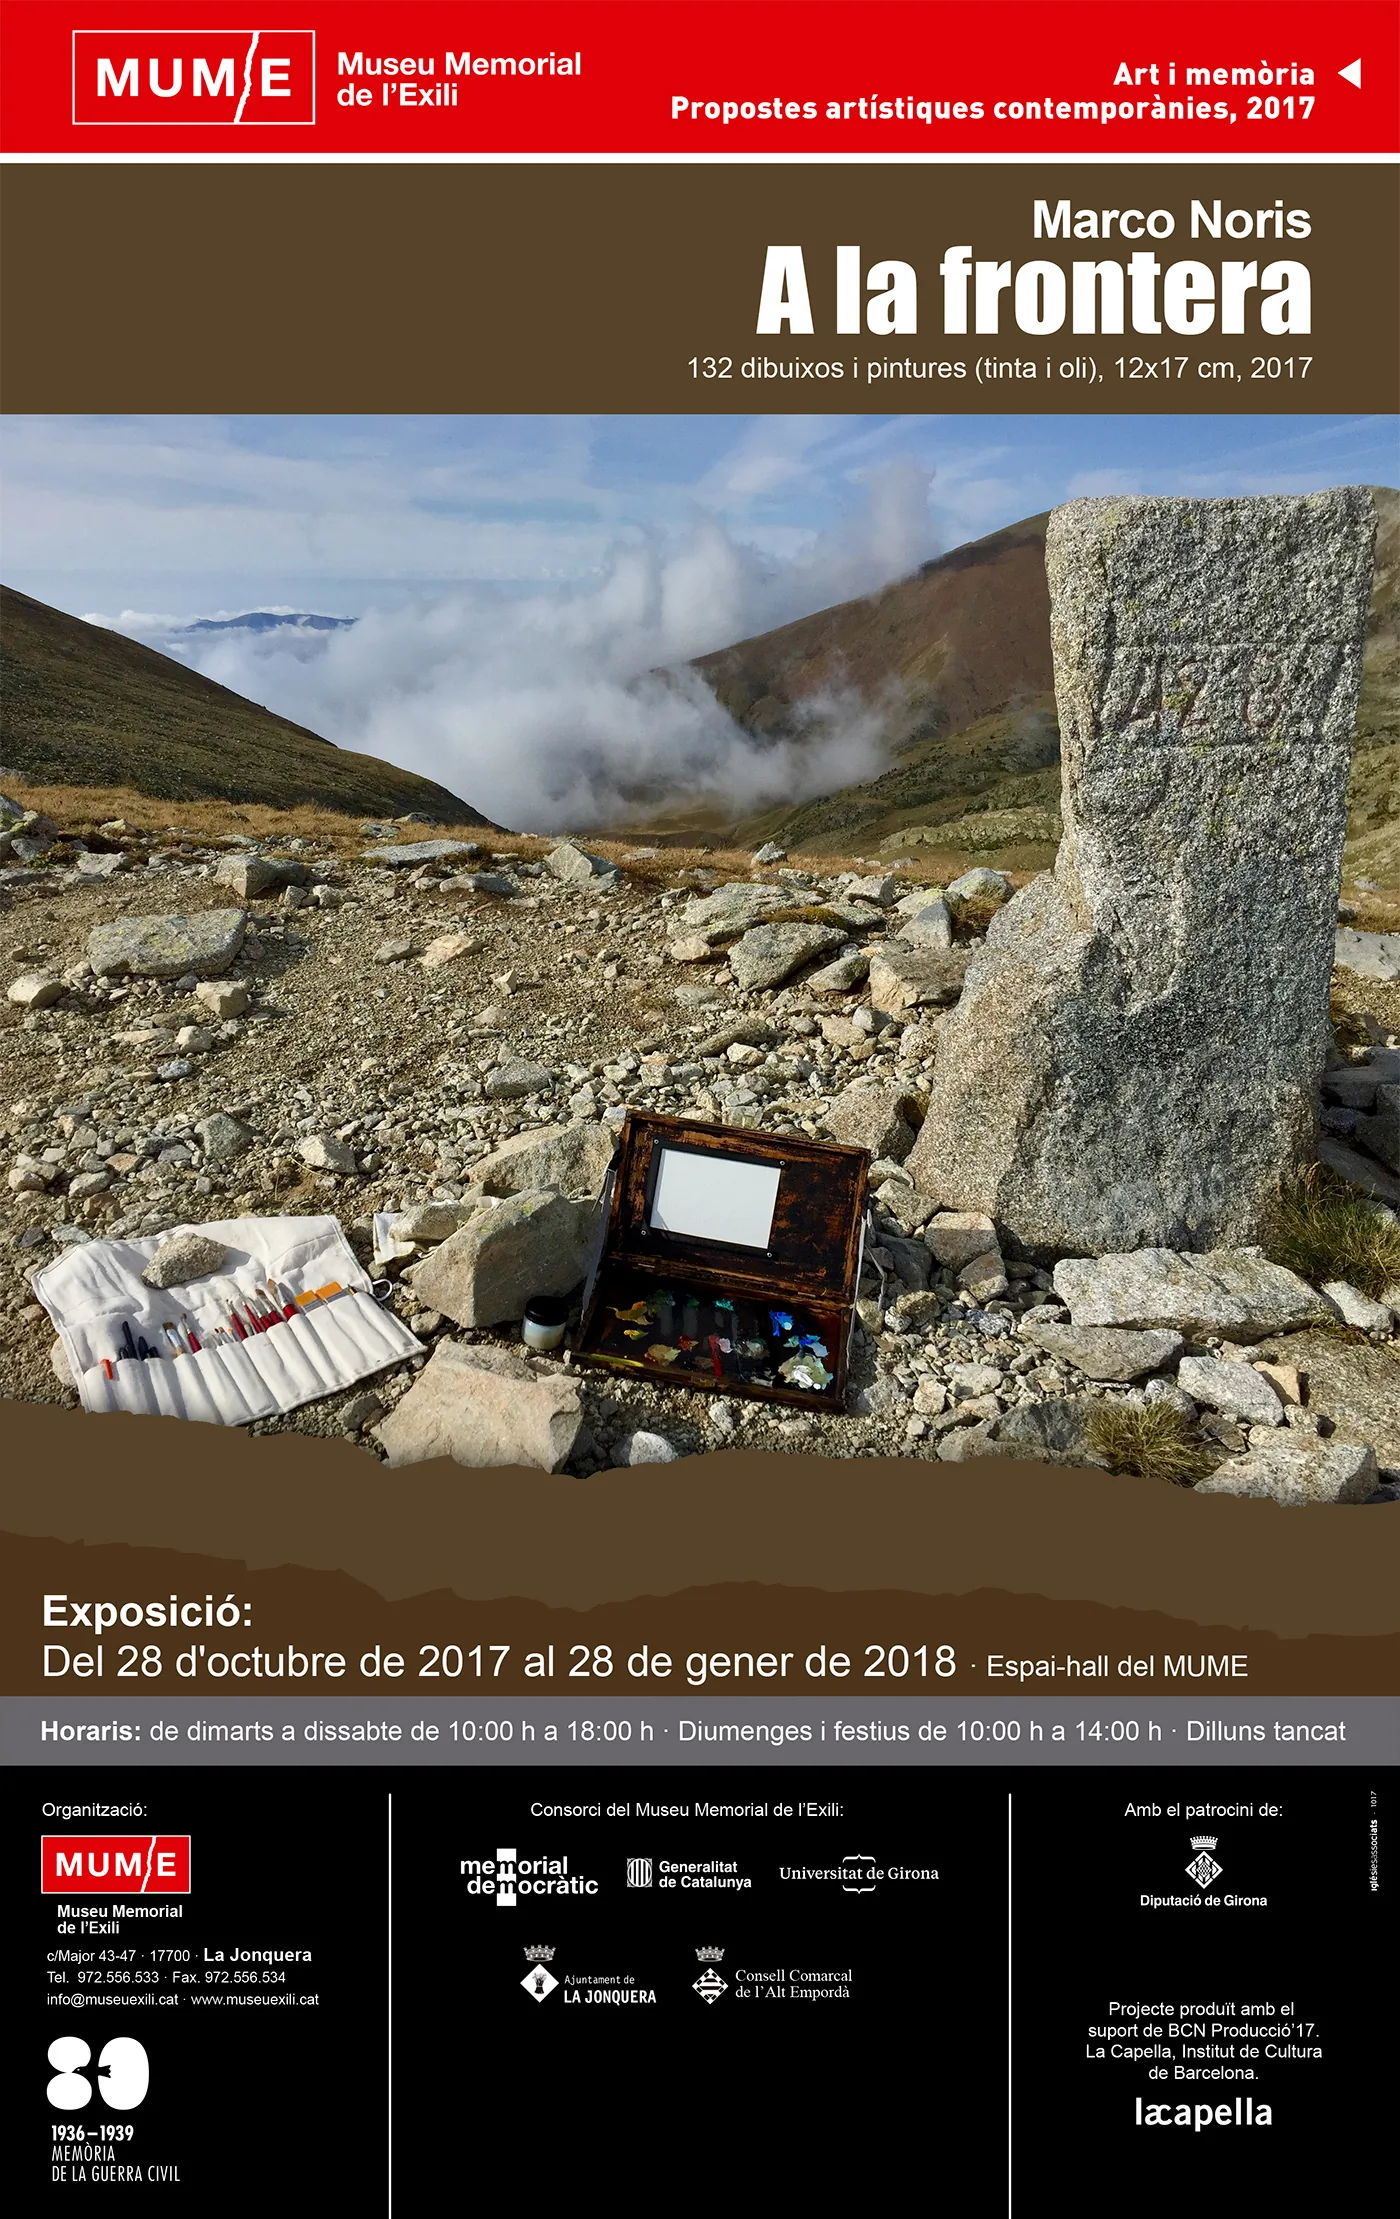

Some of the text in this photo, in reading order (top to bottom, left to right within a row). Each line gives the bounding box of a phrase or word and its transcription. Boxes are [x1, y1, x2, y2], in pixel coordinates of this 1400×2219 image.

[338, 52, 580, 75] Museu Memorial
[1113, 60, 1314, 85] Art i memòria
[337, 83, 372, 106] de
[672, 94, 1315, 124] Propostes artístiques contemporànies, 2017
[1034, 200, 1311, 238] Marco Noris
[756, 246, 1311, 335] A la frontera
[689, 357, 1312, 384] 132 dibuixos i pintures (tinta i oli), 12x17 cm, 2017
[44, 1594, 251, 1634] Exposició:
[44, 1645, 1248, 1685] Del 28 d'octubre de 2017 al 28 de gener de 2018 Espai-hall del MUME
[42, 1721, 1346, 1746] Horaris: de dimarts a dissabte de 10:00 h a 18:00 h Diumenges i festius de 10:00 h a 14:00 h Dilluns tancat
[42, 1803, 146, 1820] Organització:
[531, 1803, 600, 1816] Consorci
[607, 1803, 629, 1816] del
[636, 1803, 688, 1816] Museu
[695, 1803, 767, 1816] Memorial
[773, 1803, 793, 1816] de
[1124, 1803, 1282, 1820] Amb el patrocini de:
[461, 1856, 568, 1875] memorial
[659, 1861, 737, 1873] Generalitat
[779, 1867, 939, 1879] Universitat de Girona
[467, 1876, 599, 1894] democràtic
[659, 1876, 751, 1891] de Catalunya
[1141, 1894, 1267, 1909] Diputació de Girona
[58, 1905, 182, 1917] Museu Memorial
[57, 1921, 76, 1934] de
[47, 1948, 311, 1965] c/Major 43-47 17700 La Jonquera
[47, 1971, 286, 1983] Tel. 972.556.533 Fax. 972.556.534
[565, 1975, 634, 1985] Ajuntament de
[736, 1969, 852, 1981] Consell Comarcal
[48, 1993, 319, 2008] info@museuexili.cat www.museuexili.cat
[564, 1990, 656, 2006] LA JONQUERA
[736, 1986, 750, 1997] de
[790, 1986, 849, 2001] Empordà
[1110, 2002, 1294, 2019] Projecte produït amb el
[1089, 2024, 1138, 2040] suport
[1143, 2023, 1162, 2037] de
[1169, 2023, 1205, 2037] BCN
[1087, 2044, 1322, 2061] La Capella, Institut de Cultura
[1149, 2066, 1258, 2079] de Barcelona.
[52, 2142, 115, 2161] MEMÒRIA
[53, 2166, 180, 2181] DE LA GUERRA CIVIL
